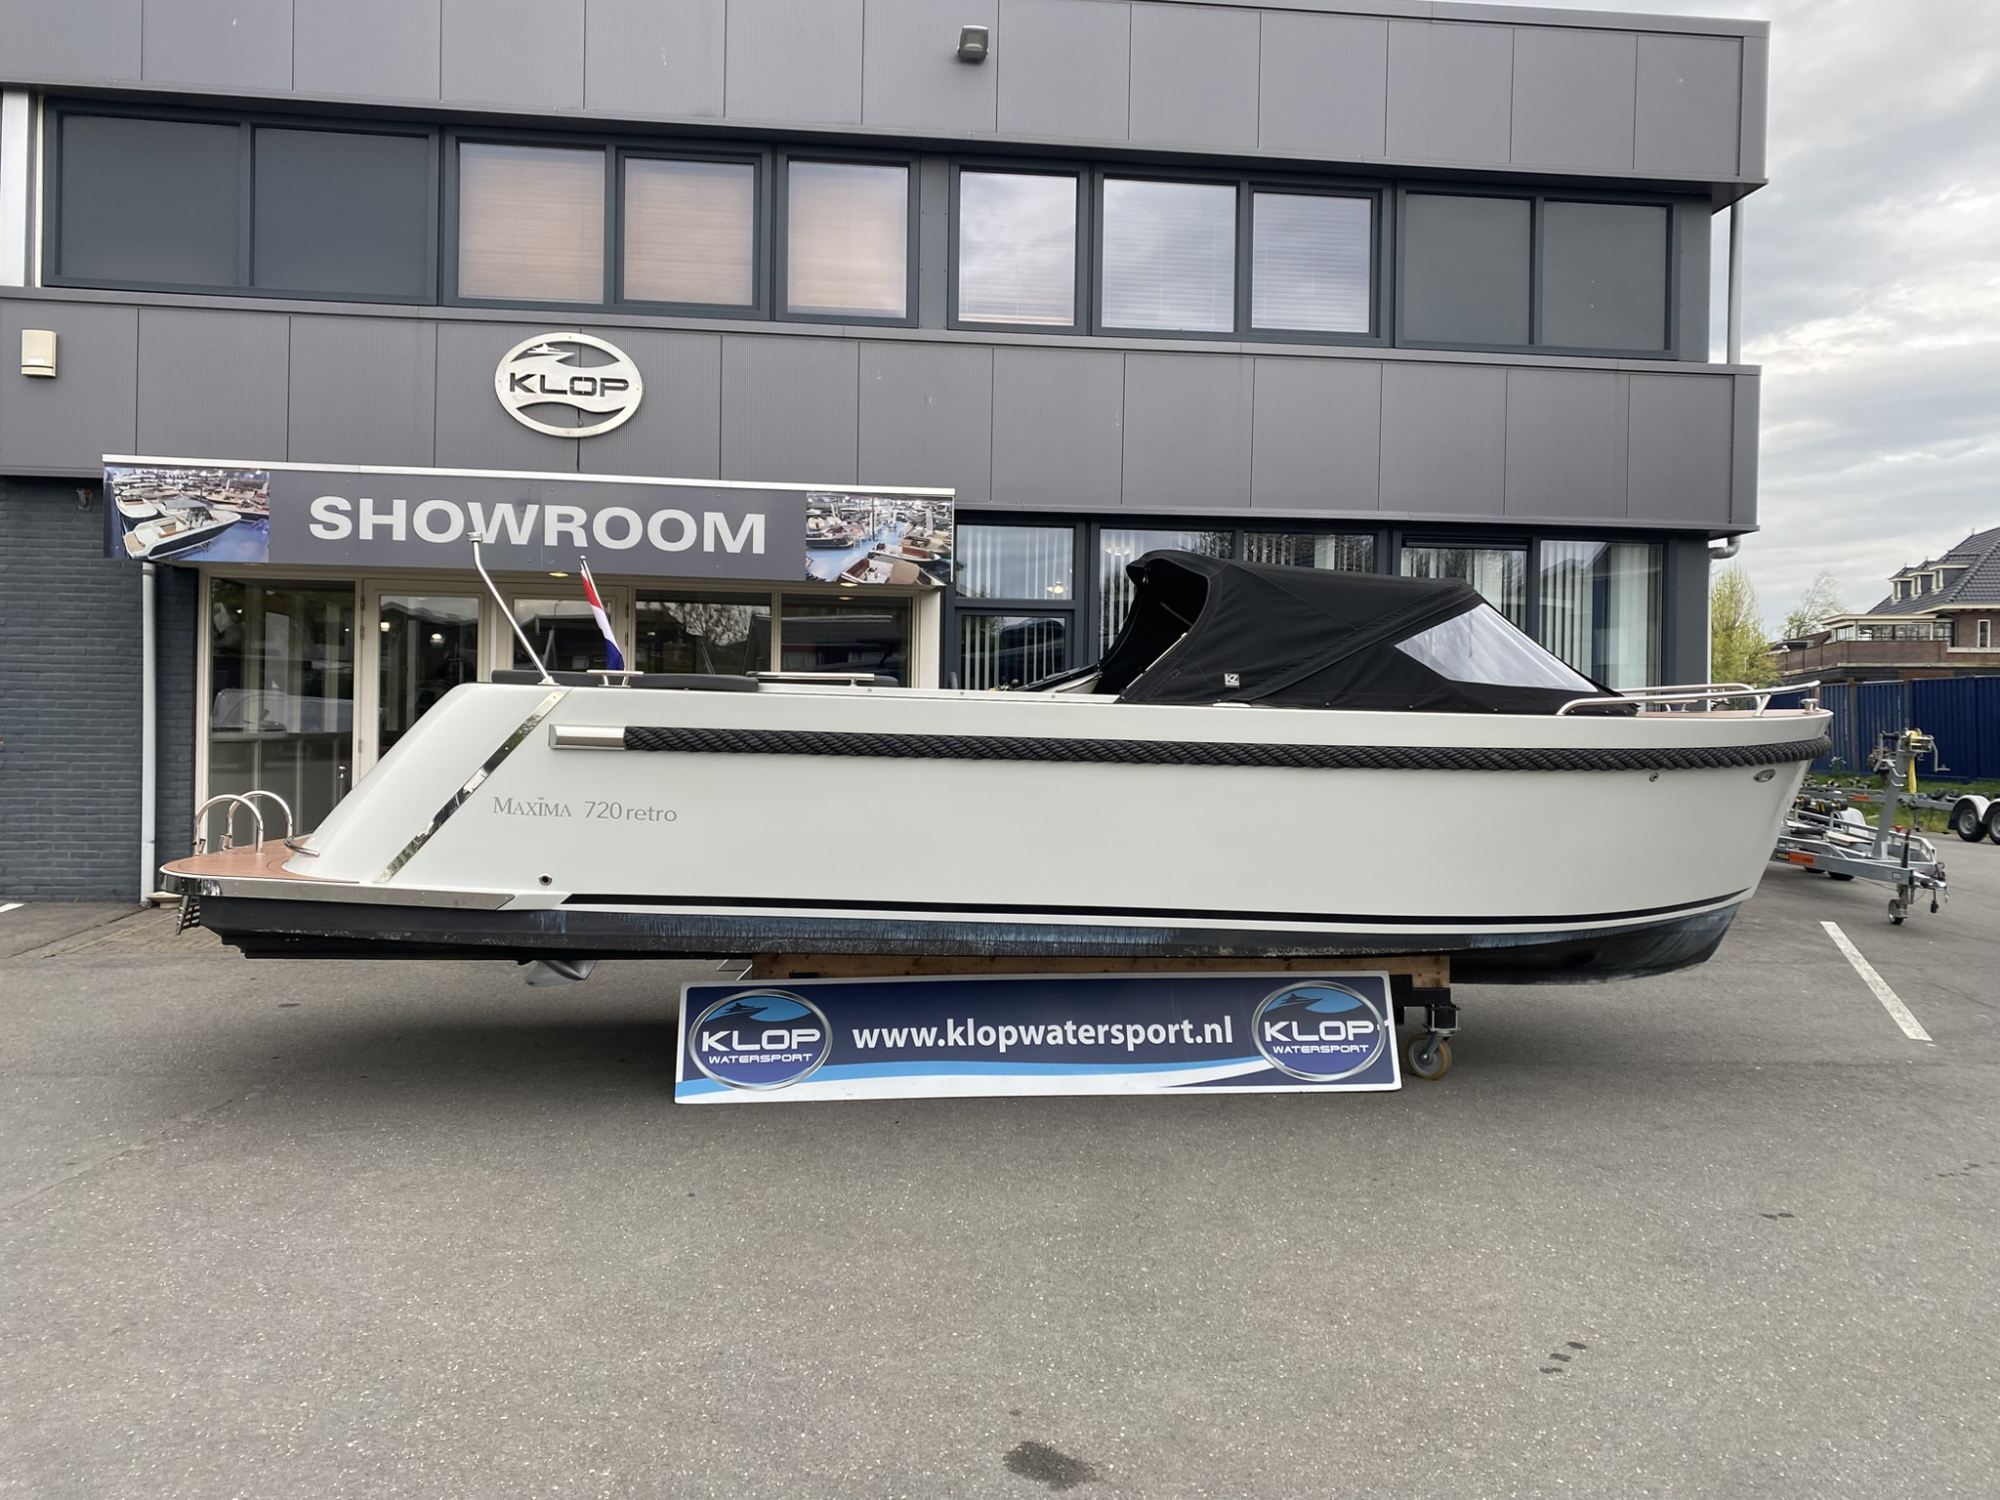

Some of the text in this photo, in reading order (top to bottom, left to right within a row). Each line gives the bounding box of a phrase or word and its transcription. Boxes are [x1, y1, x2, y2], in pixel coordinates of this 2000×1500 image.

[509, 372, 630, 398] KLOP
[308, 495, 766, 555] SHOWROOM
[584, 801, 624, 820] 720
[625, 806, 678, 822] retro
[701, 1028, 821, 1052] KLOP
[851, 1015, 1234, 1053] www.klopwatersport.nl
[1264, 1020, 1375, 1042] KLOP
[708, 1053, 814, 1065] WATERSPORT
[1272, 1044, 1370, 1054] WATERSPORT
